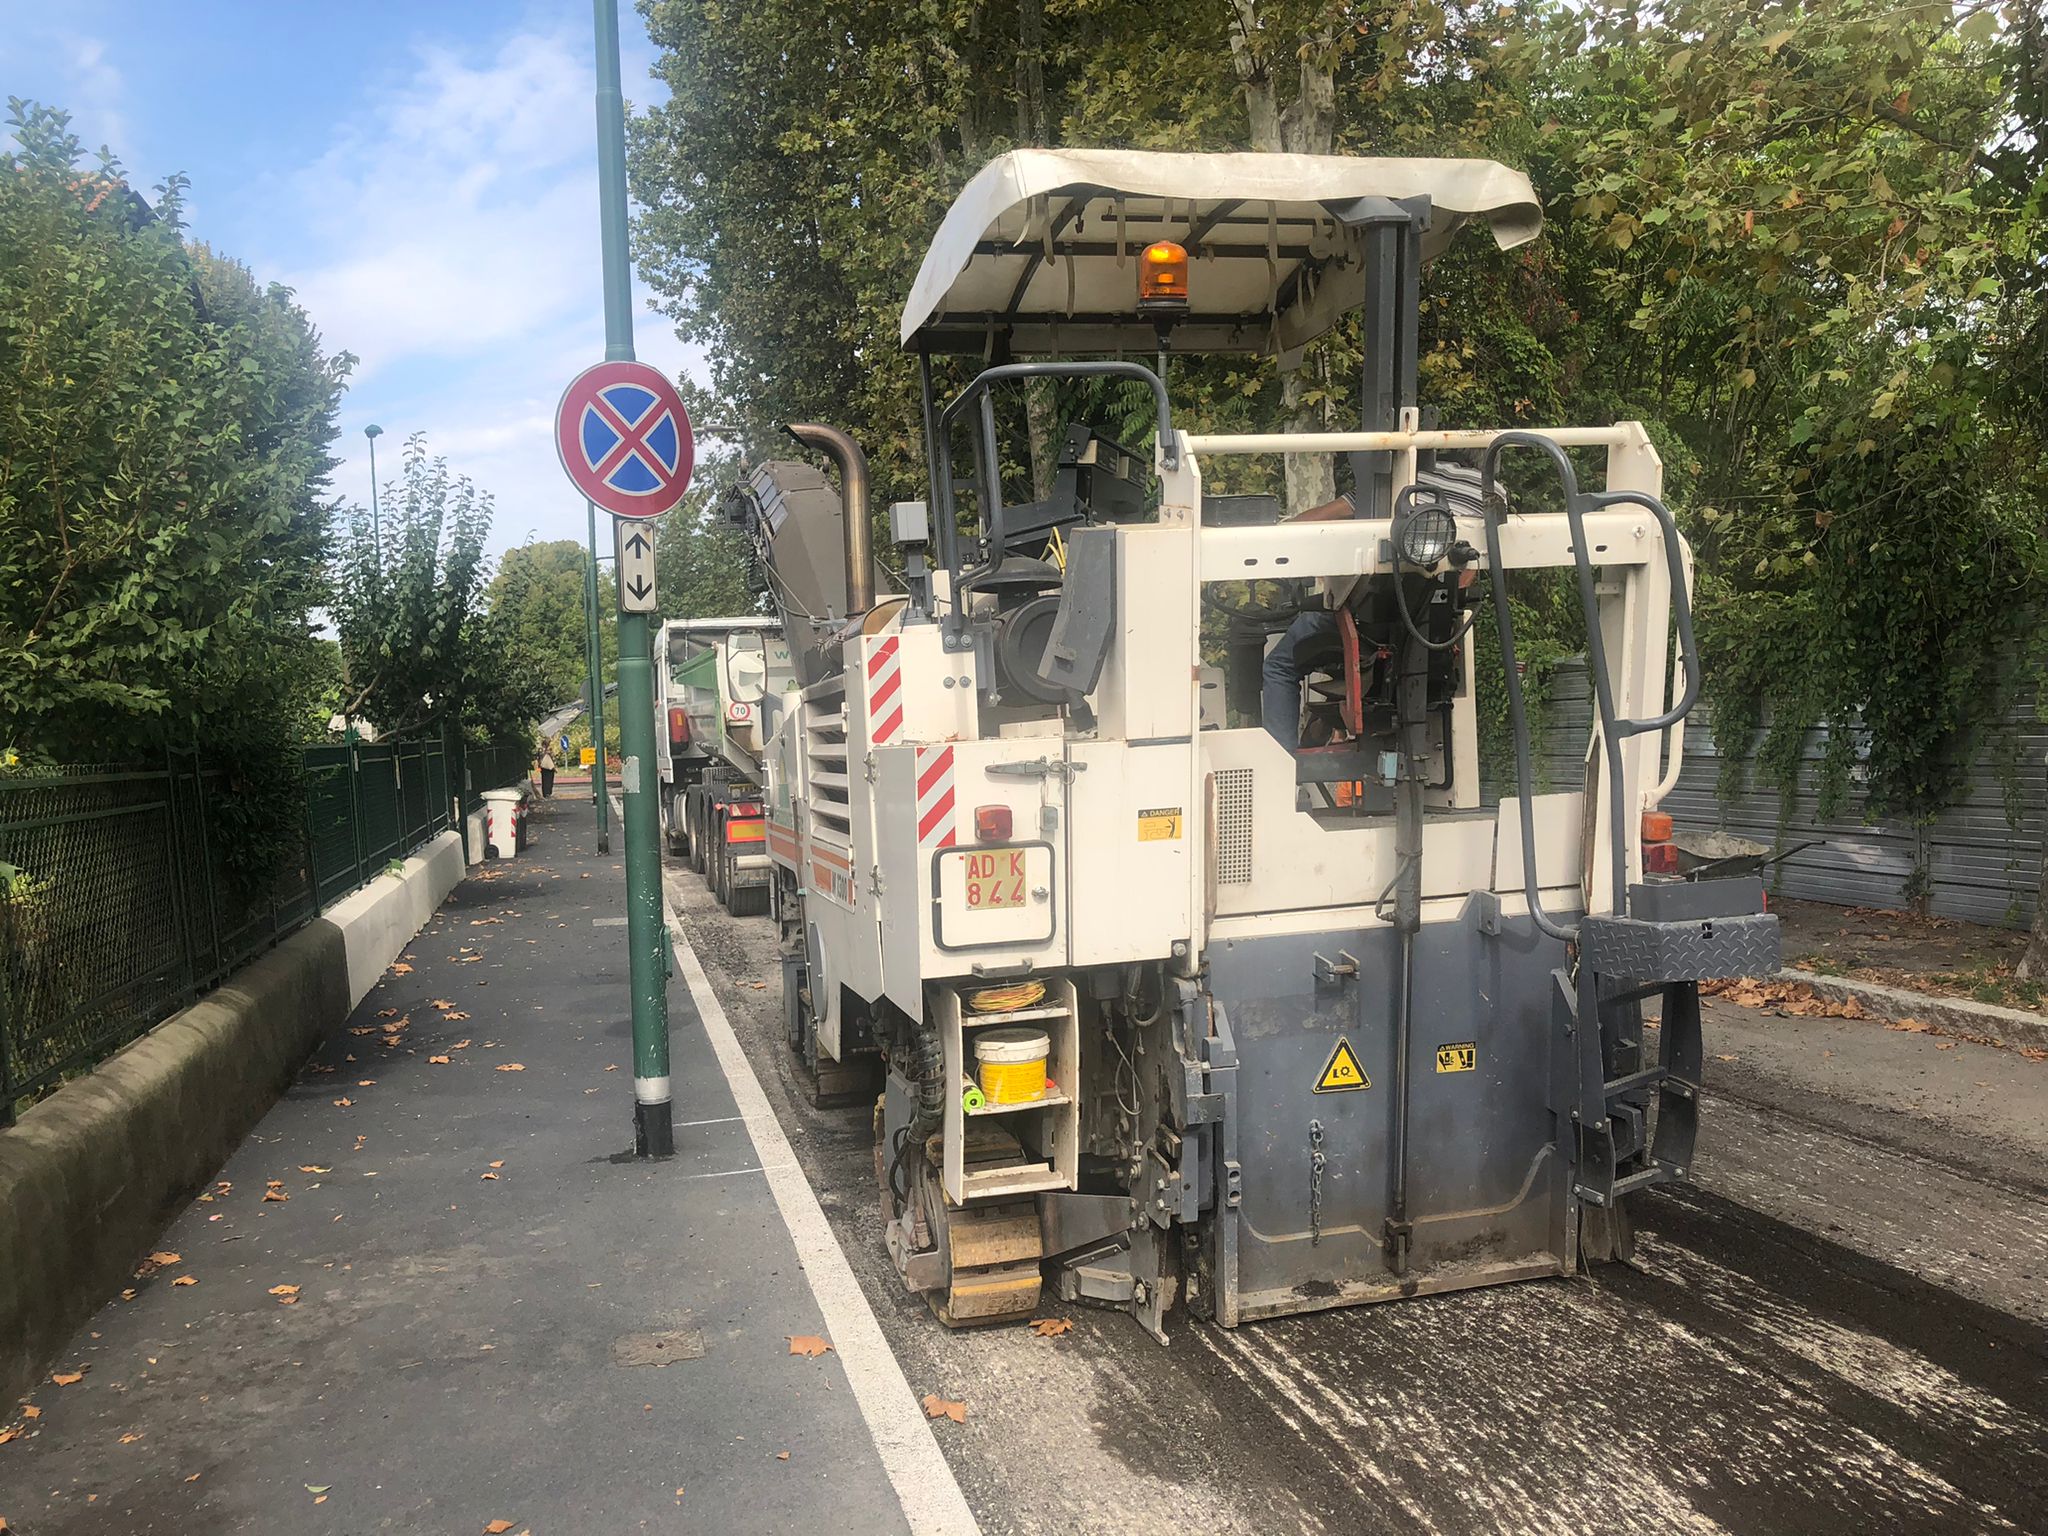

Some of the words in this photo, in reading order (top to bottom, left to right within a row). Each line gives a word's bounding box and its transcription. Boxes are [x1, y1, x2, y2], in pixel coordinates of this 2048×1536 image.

[735, 707, 746, 715] 70
[1149, 808, 1180, 817] DANGER
[967, 855, 995, 879] AD
[1010, 851, 1024, 876] K
[967, 877, 1024, 906] 844
[1445, 1042, 1474, 1051] WARNING
